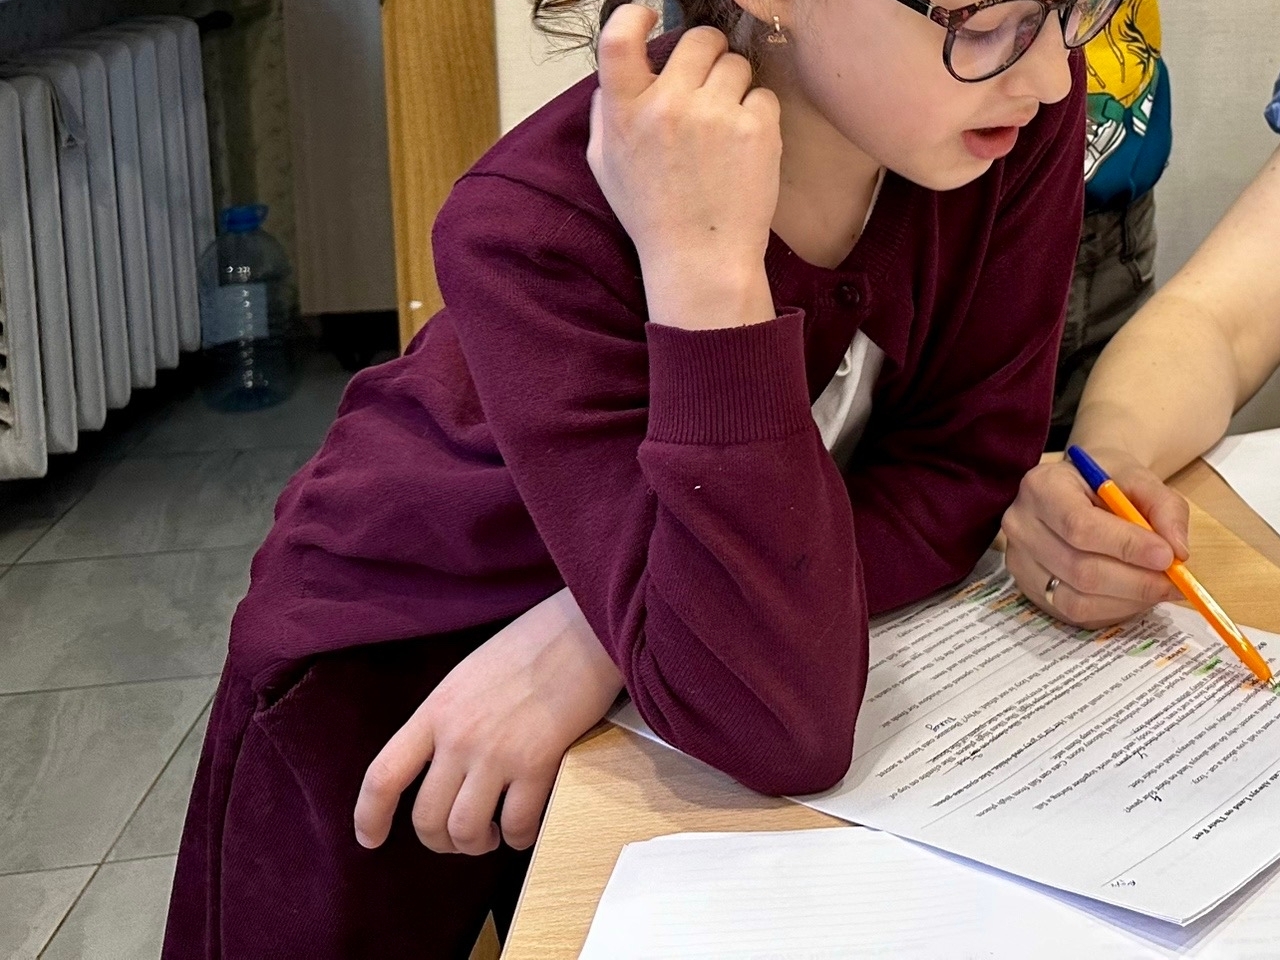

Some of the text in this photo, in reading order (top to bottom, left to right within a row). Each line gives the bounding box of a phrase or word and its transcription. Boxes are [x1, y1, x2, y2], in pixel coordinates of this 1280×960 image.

[1260, 718, 1276, 730] want
[1223, 726, 1240, 736] why
[1245, 733, 1259, 742] tell
[1234, 740, 1249, 750] you
[1187, 749, 1210, 765] always
[1050, 759, 1068, 771] Cats
[1175, 764, 1192, 775] land
[1207, 764, 1219, 772] cat
[1247, 780, 1271, 797] Always
[1232, 796, 1252, 810] Land
[1223, 808, 1234, 816] on
[1206, 815, 1228, 829] Their
[1191, 828, 1210, 840] Feet
